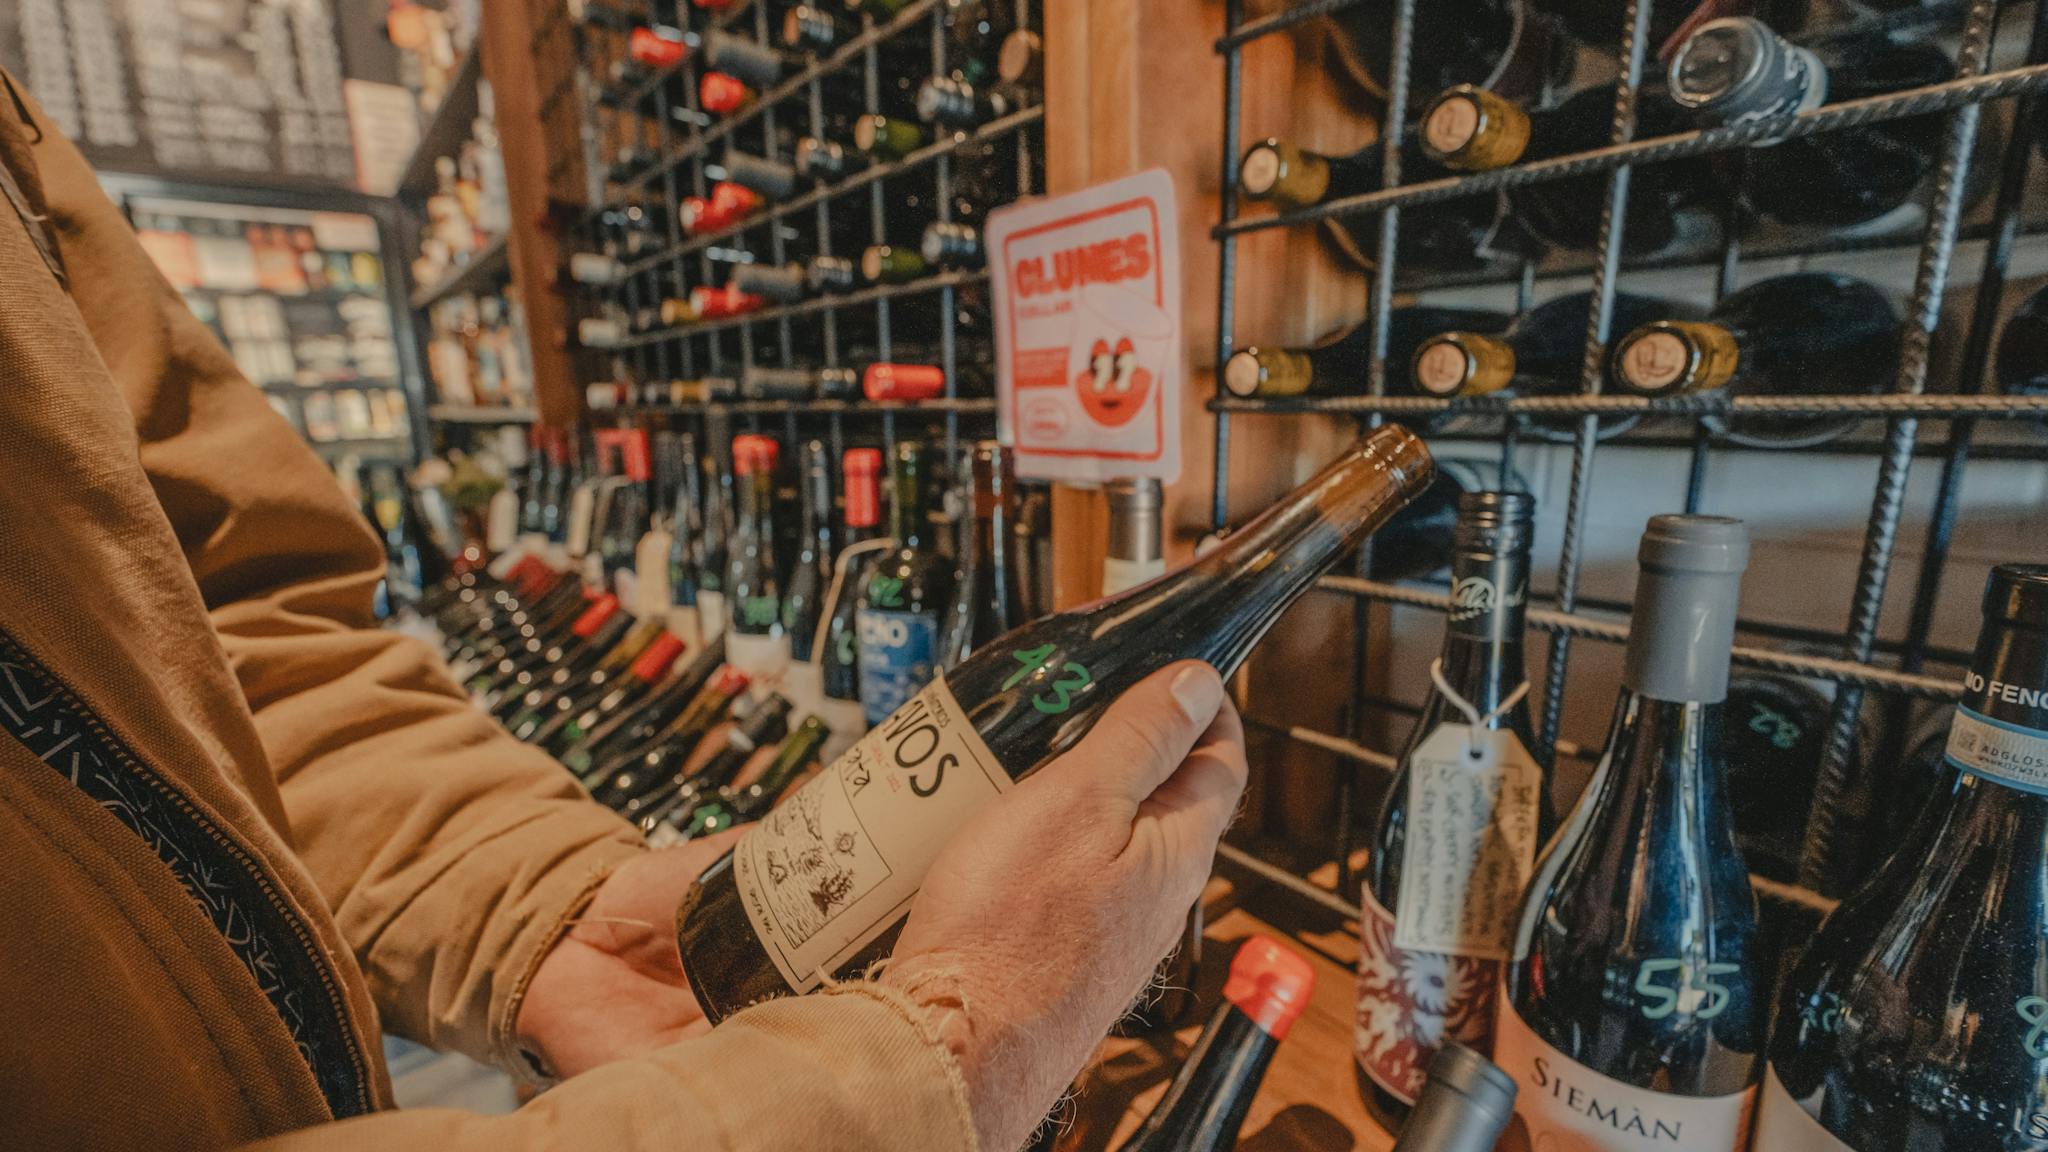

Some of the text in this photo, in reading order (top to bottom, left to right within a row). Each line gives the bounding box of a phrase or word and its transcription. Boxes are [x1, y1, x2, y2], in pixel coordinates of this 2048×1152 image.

[1015, 233, 1150, 298] CLUNES
[1635, 958, 1740, 1019] 55
[1531, 1056, 1682, 1142] SIEMÀN
